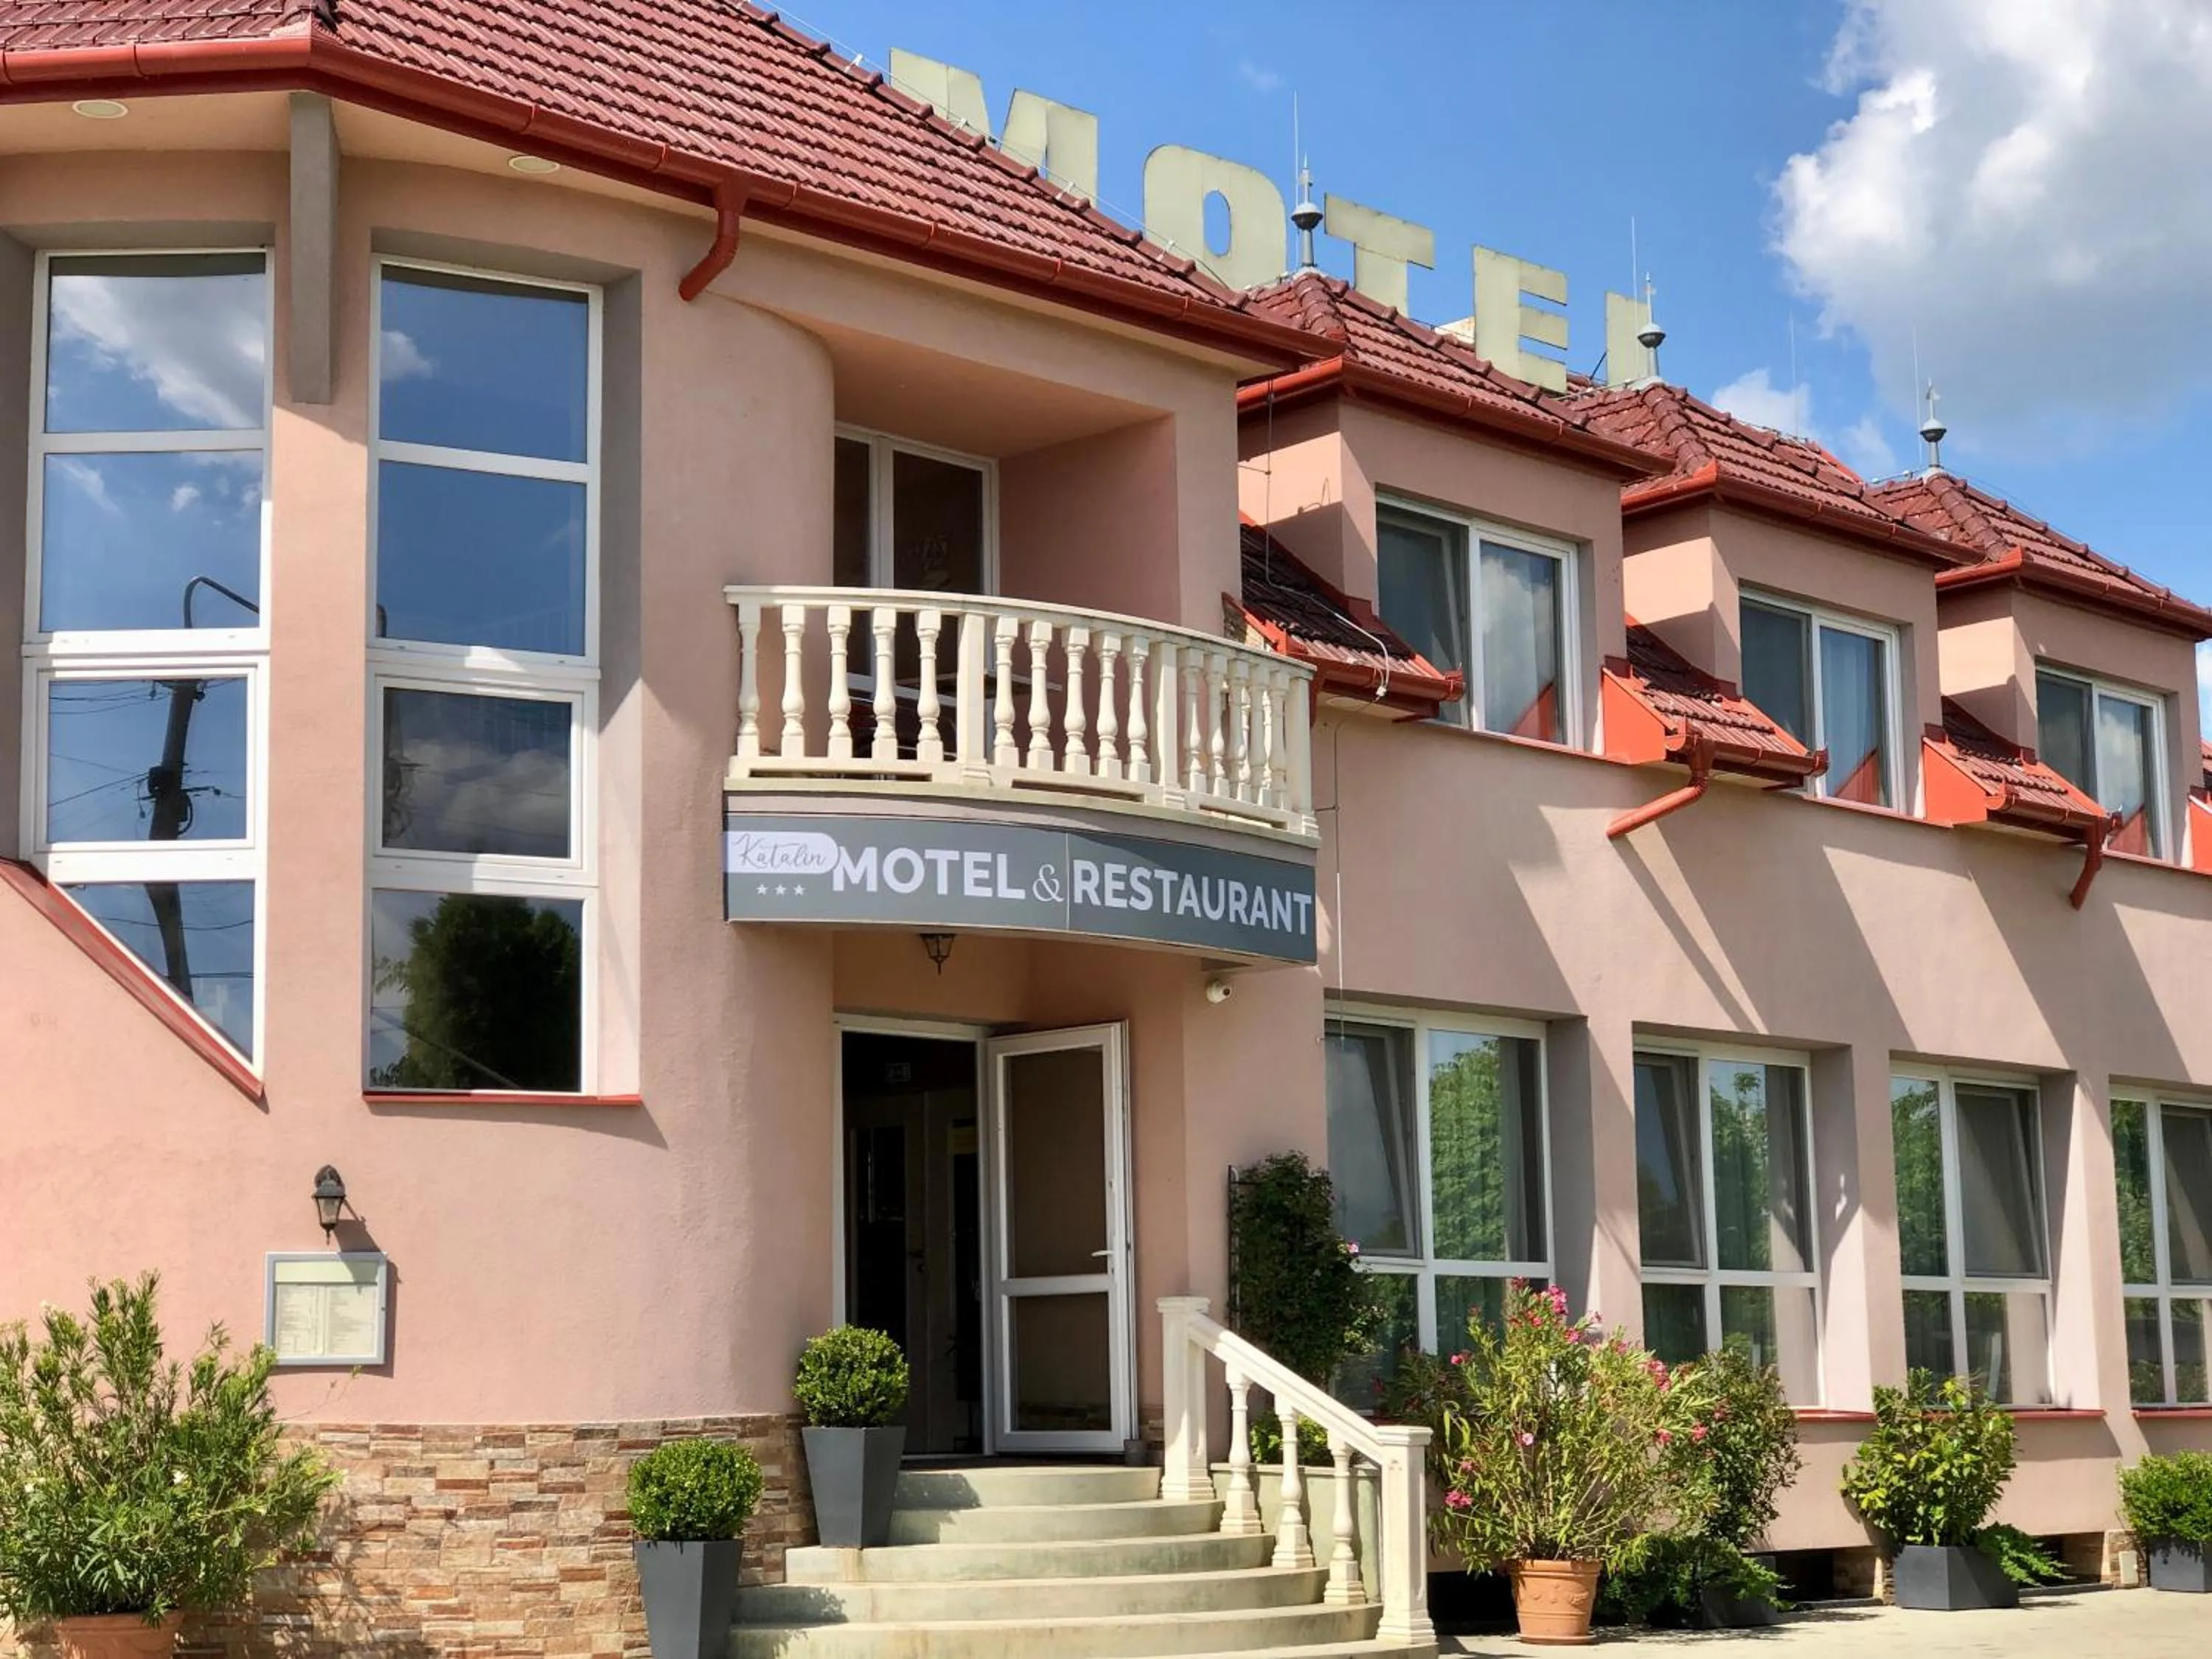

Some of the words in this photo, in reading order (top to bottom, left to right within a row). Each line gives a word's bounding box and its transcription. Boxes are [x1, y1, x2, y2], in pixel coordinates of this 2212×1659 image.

[731, 833, 827, 869] Katalin
[832, 846, 1026, 900] MOTEL
[1032, 864, 1065, 903] &
[1073, 859, 1312, 935] RESTAURANT
